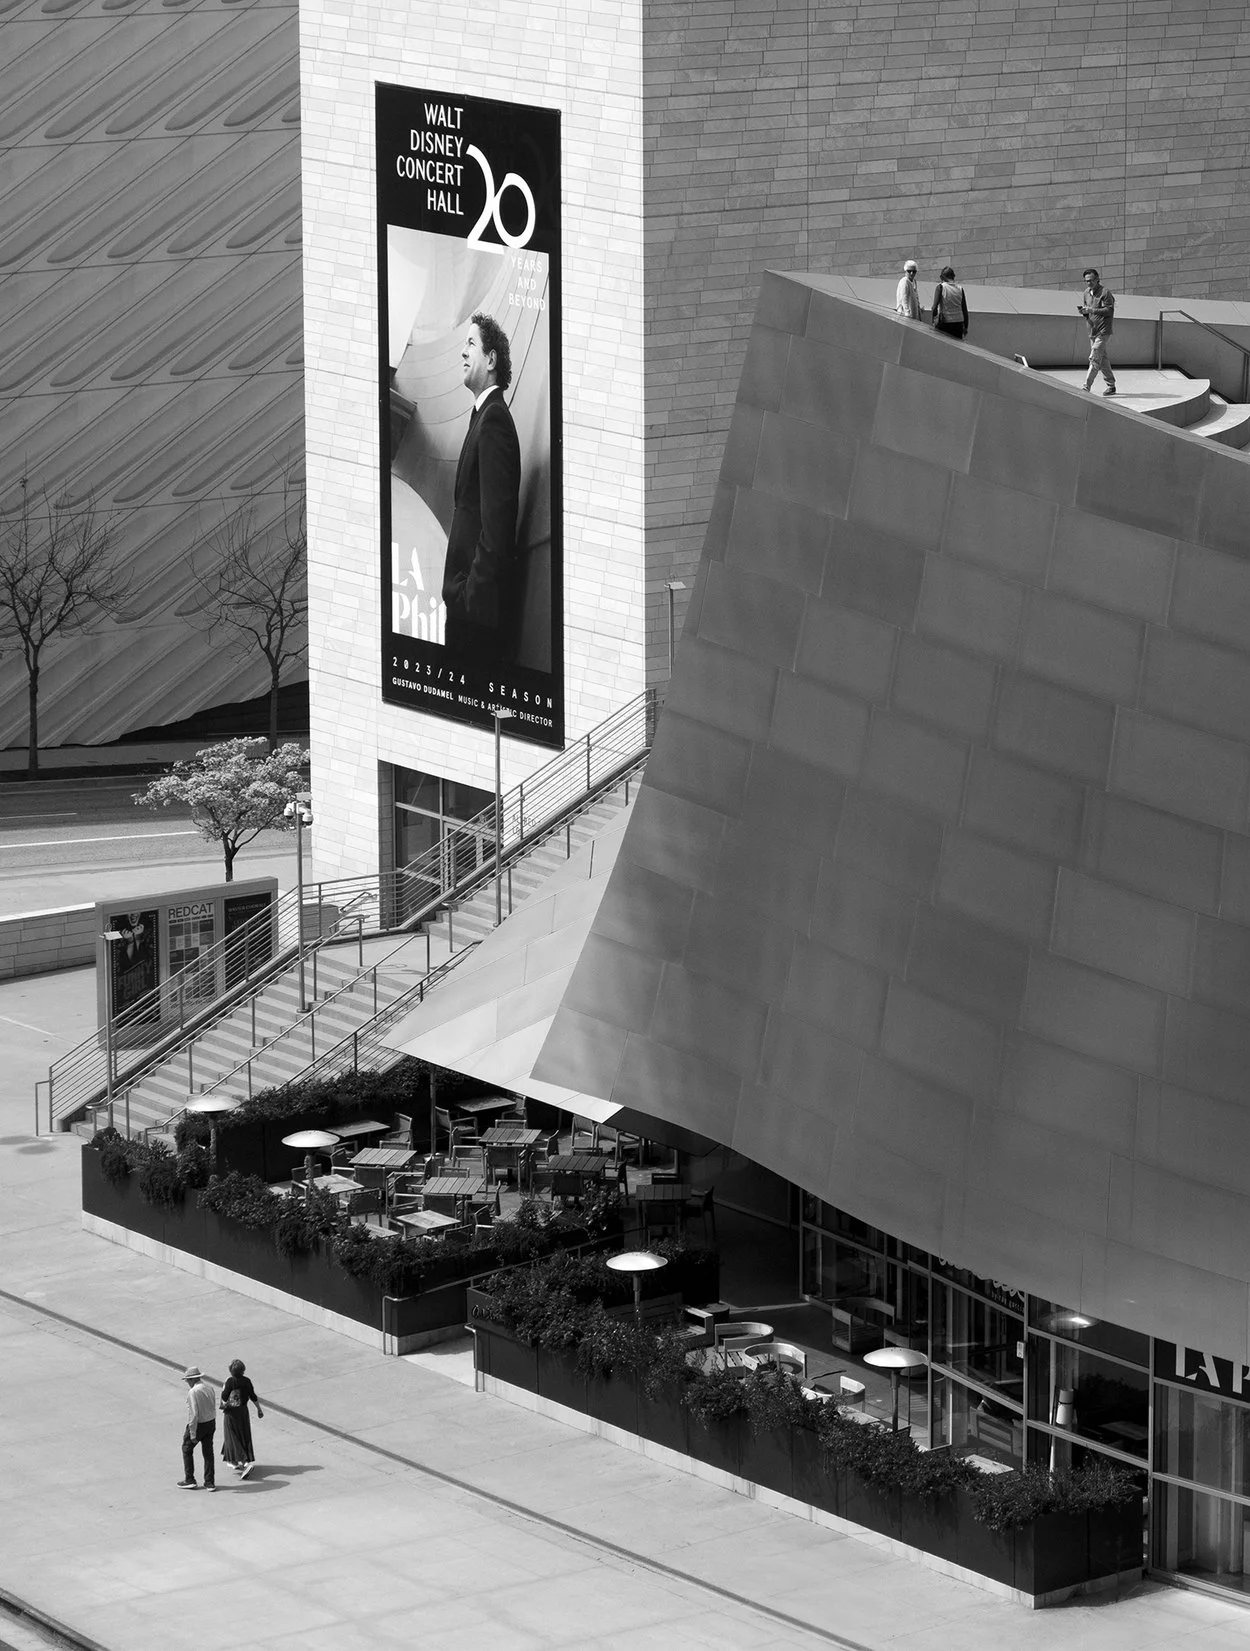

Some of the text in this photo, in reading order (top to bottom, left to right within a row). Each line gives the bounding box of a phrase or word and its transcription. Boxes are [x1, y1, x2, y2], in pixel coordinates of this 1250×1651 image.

[424, 103, 464, 130] WALT
[410, 129, 464, 158] DISNEY
[396, 155, 464, 187] CONCERT
[427, 188, 464, 216] HALL
[466, 143, 536, 255] 20
[510, 257, 543, 273] YEARS
[518, 278, 537, 291] AND
[508, 293, 546, 311] BEYOND
[391, 541, 425, 592] LA
[391, 590, 448, 646] Phil
[392, 656, 553, 709] 2023/24 SEASON
[392, 677, 422, 692] GUSTAVO
[423, 684, 454, 701] DUDAMEL
[458, 694, 479, 708] MUSIC
[480, 700, 486, 710] &
[519, 711, 553, 728] DIRECTOR
[168, 902, 213, 919] REDCAT
[1175, 1343, 1221, 1389] LA
